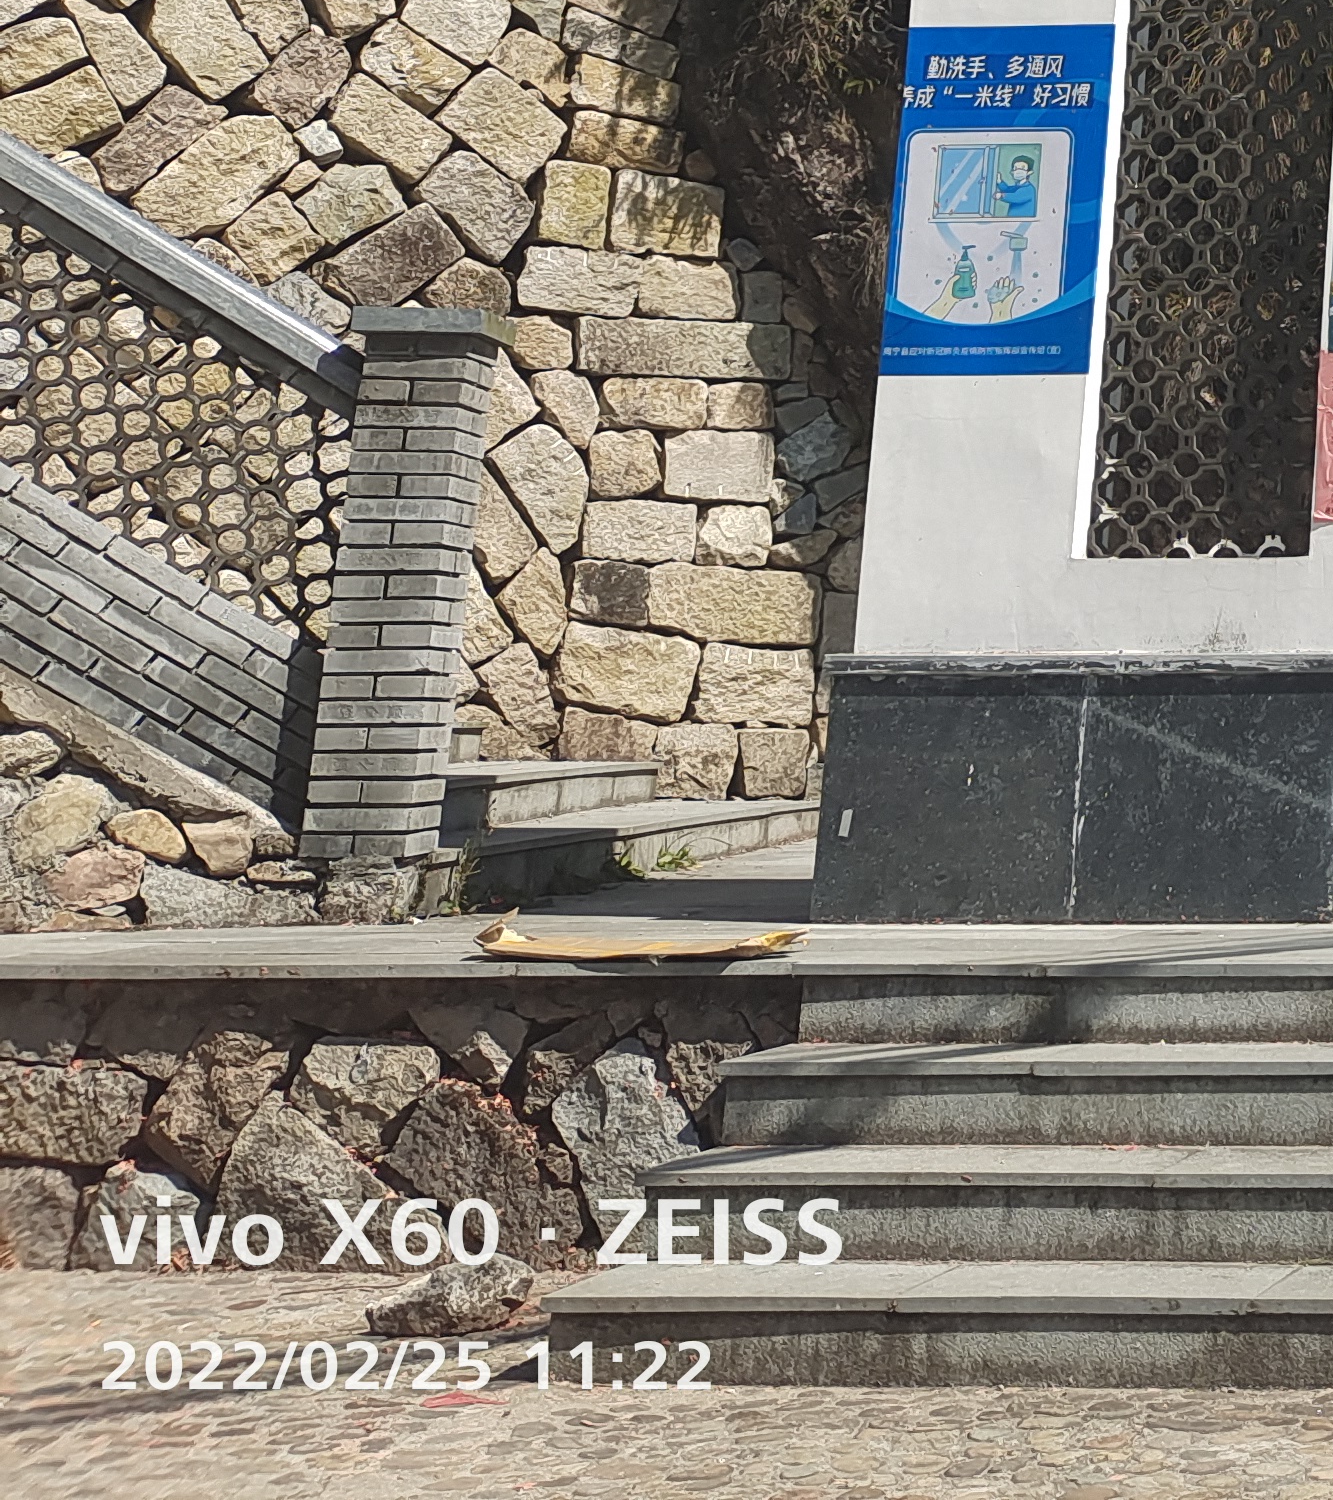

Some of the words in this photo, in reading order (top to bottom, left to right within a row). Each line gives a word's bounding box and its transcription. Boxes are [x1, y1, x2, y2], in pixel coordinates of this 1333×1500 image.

[926, 55, 1066, 80] 勤洗手、多通风
